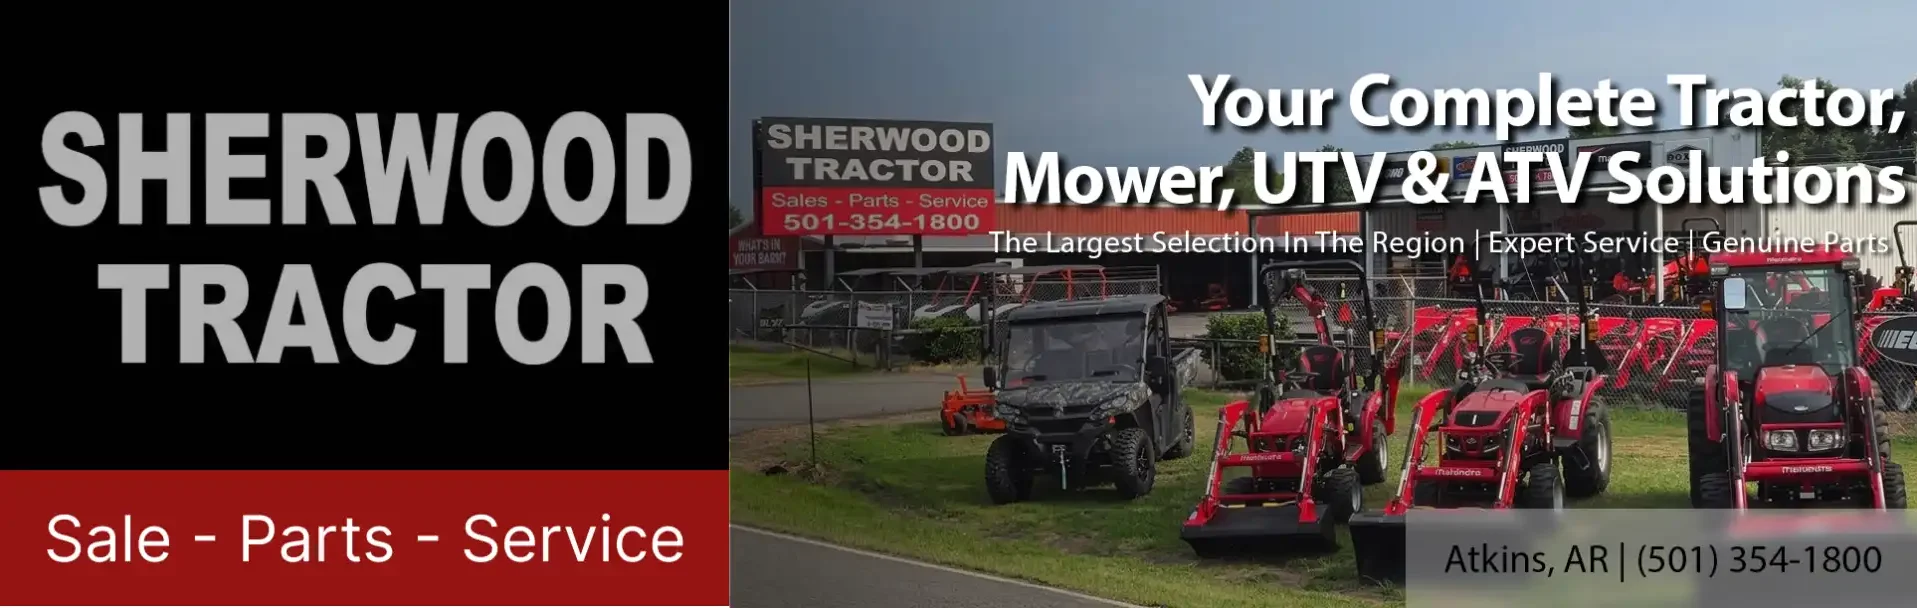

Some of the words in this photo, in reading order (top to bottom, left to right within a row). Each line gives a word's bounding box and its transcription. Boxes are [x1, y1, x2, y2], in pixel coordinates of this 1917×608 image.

[767, 124, 991, 153] SHERWOOD
[786, 157, 974, 182] TRACTOR
[771, 192, 828, 208] Sales
[849, 193, 899, 209] Parts
[919, 193, 988, 209] Service
[783, 213, 980, 231] 501-354-1800
